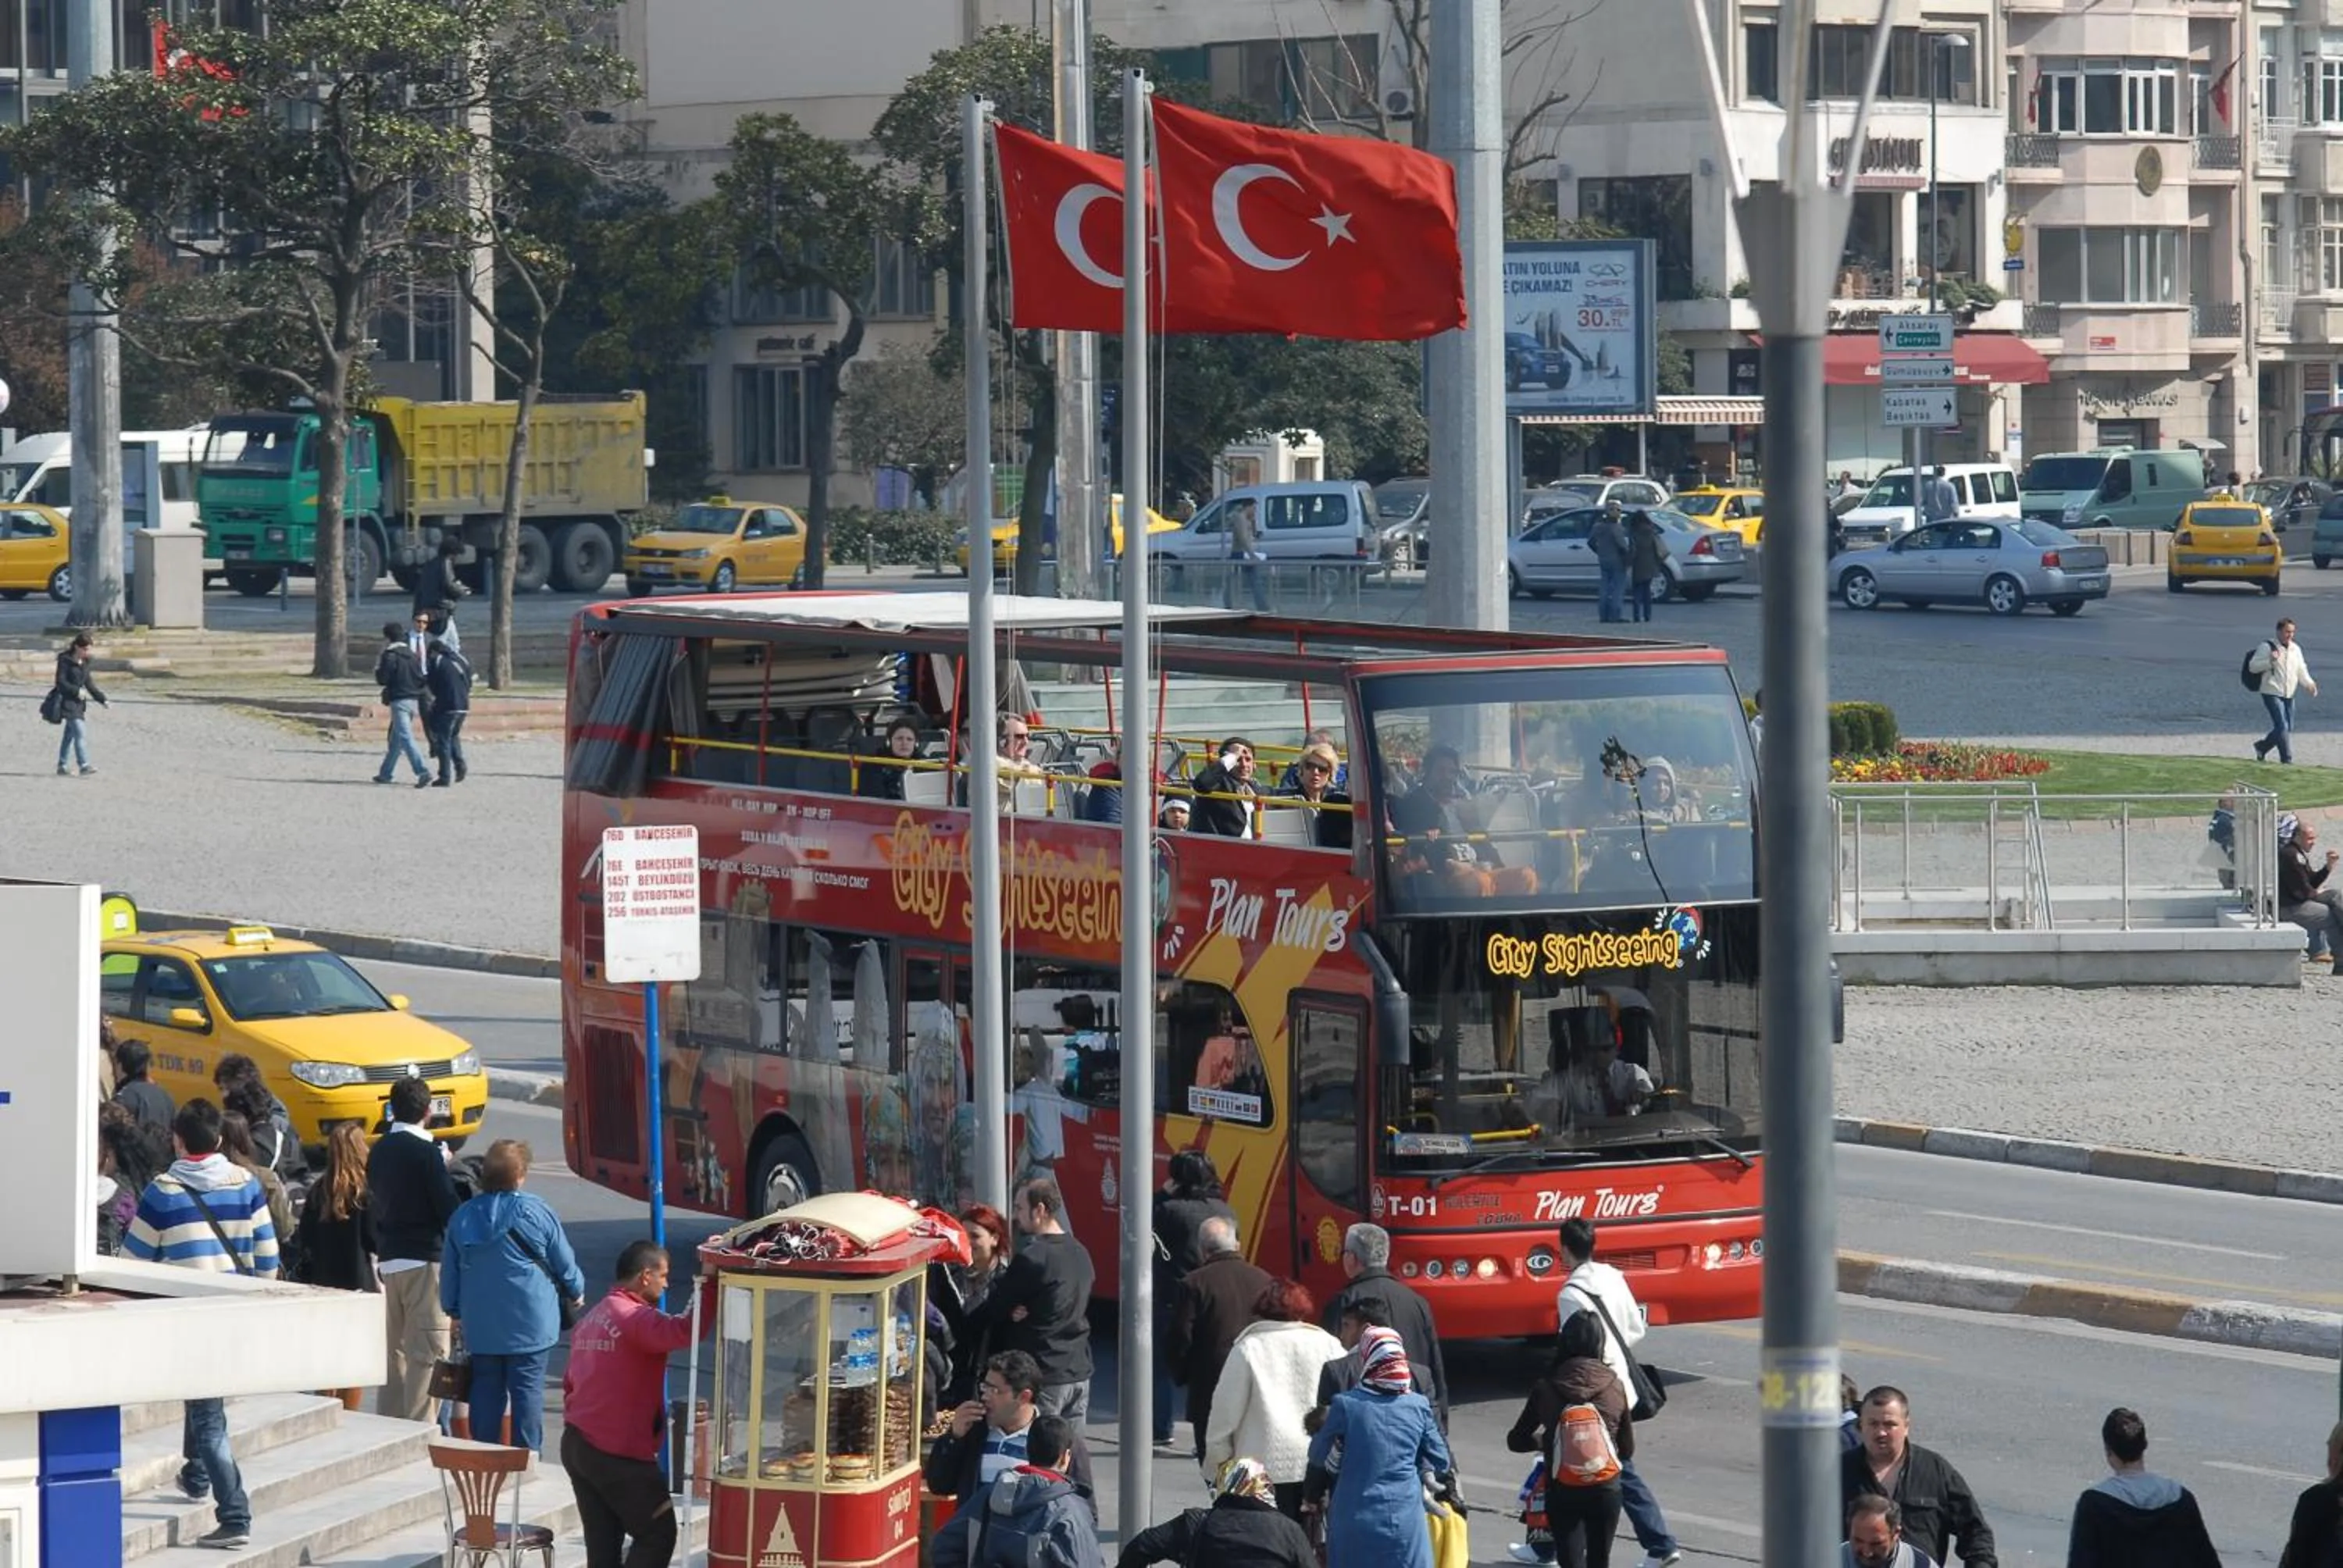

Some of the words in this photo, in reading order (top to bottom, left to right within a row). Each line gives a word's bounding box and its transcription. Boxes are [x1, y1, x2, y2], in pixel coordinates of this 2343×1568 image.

[1532, 262, 1581, 275] YOLUNA
[1511, 280, 1573, 296] ÇIKAMAZ!
[893, 809, 953, 929] City
[608, 891, 626, 903] 202
[608, 906, 626, 918] 256
[1206, 878, 1264, 940] Plan
[1275, 888, 1350, 952] Tours
[1488, 933, 1537, 978] City
[1542, 927, 1679, 976] Sightseeing
[1388, 1195, 1437, 1216] T-01
[1535, 1189, 1585, 1220] Plan
[1594, 1187, 1660, 1218] Tours
